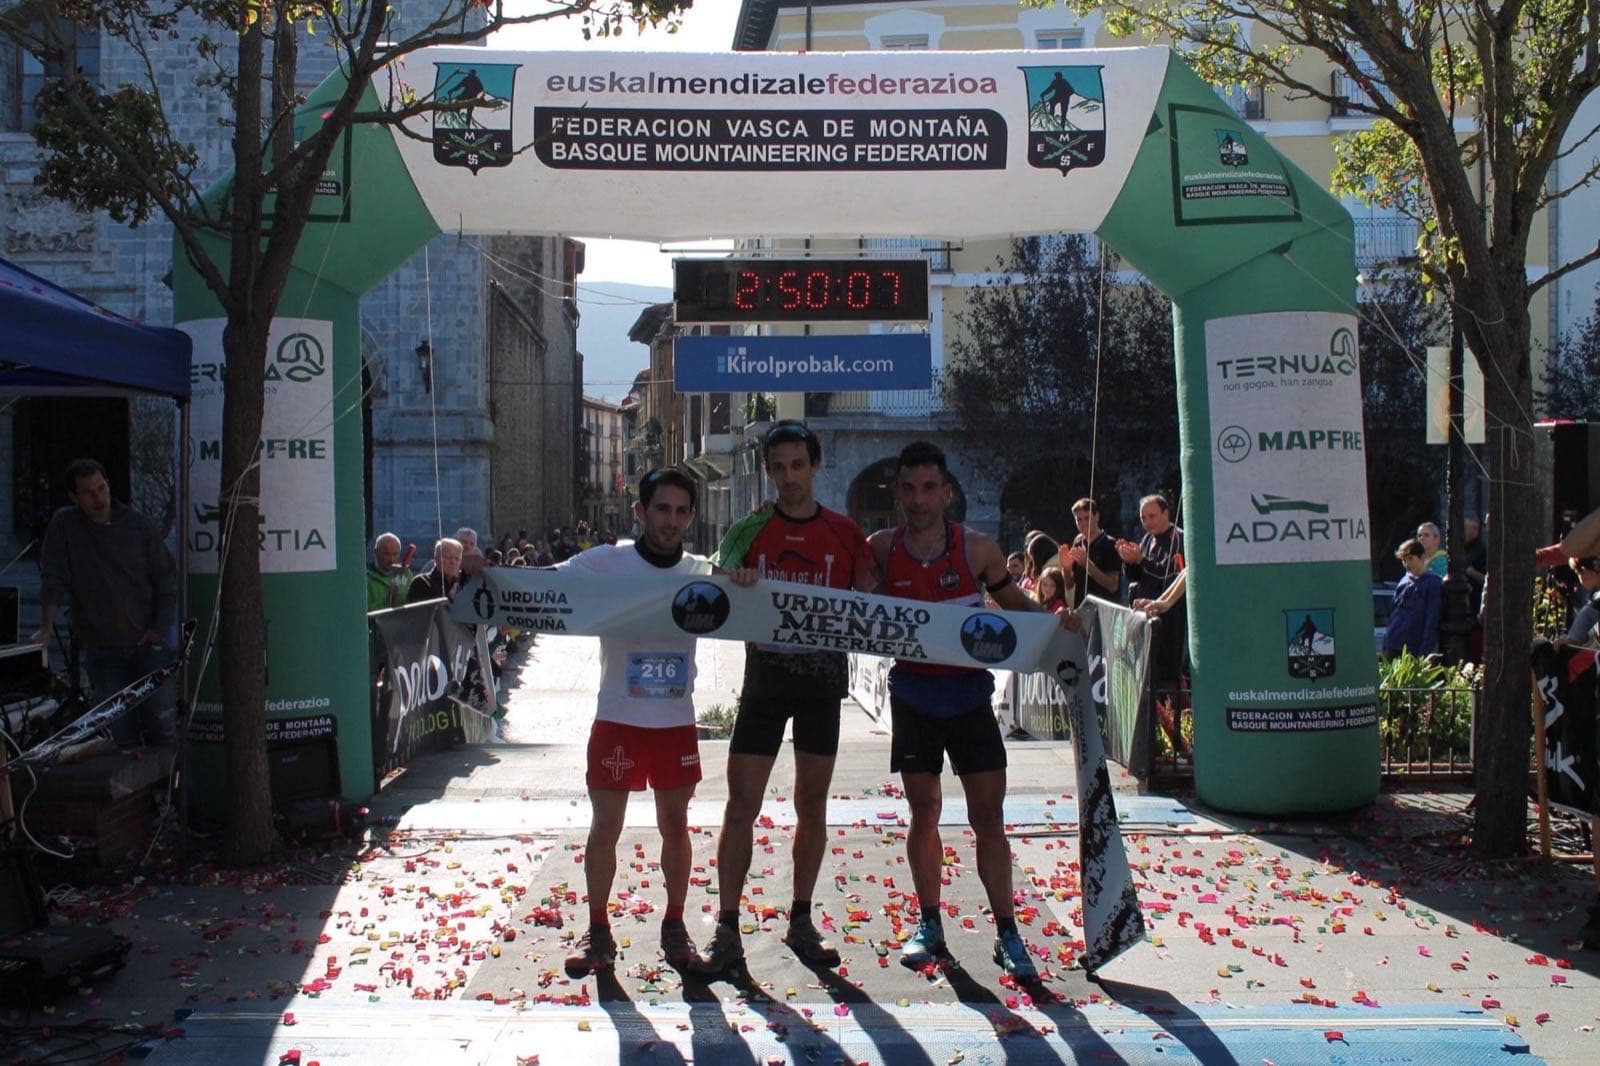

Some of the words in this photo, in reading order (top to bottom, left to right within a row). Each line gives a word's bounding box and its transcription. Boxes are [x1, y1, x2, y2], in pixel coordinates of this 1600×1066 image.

[546, 71, 998, 95] euskalmendizalefederazioa
[551, 117, 711, 138] FEDERACION
[726, 119, 809, 138] VASCA
[823, 119, 854, 137] DE
[869, 115, 989, 137] MONTAÑA
[551, 142, 647, 163] BASQUE
[655, 143, 848, 163] MOUNTAINEERING
[854, 143, 988, 162] FEDERATION
[736, 271, 900, 310] 2:50:07
[727, 347, 893, 378] Kirolprobak.com
[1216, 355, 1336, 379] TERNUA
[1258, 430, 1362, 452] MAPFRE
[1226, 518, 1367, 544] ADARTIA
[501, 589, 568, 605] URDUÑA
[771, 591, 931, 625] URDUÑAKO
[506, 615, 567, 631] ORDUÑA
[779, 610, 919, 643] MENDI
[772, 629, 928, 659] LASTERKETA
[641, 663, 677, 678] 216
[285, 717, 332, 730] MONTAÑA
[1231, 711, 1293, 720] FEDERACION
[1298, 710, 1330, 719] VASCA
[1334, 709, 1347, 718] DE
[1231, 721, 1268, 730] BASQUE
[1270, 719, 1345, 730] MOUNTAINEERING
